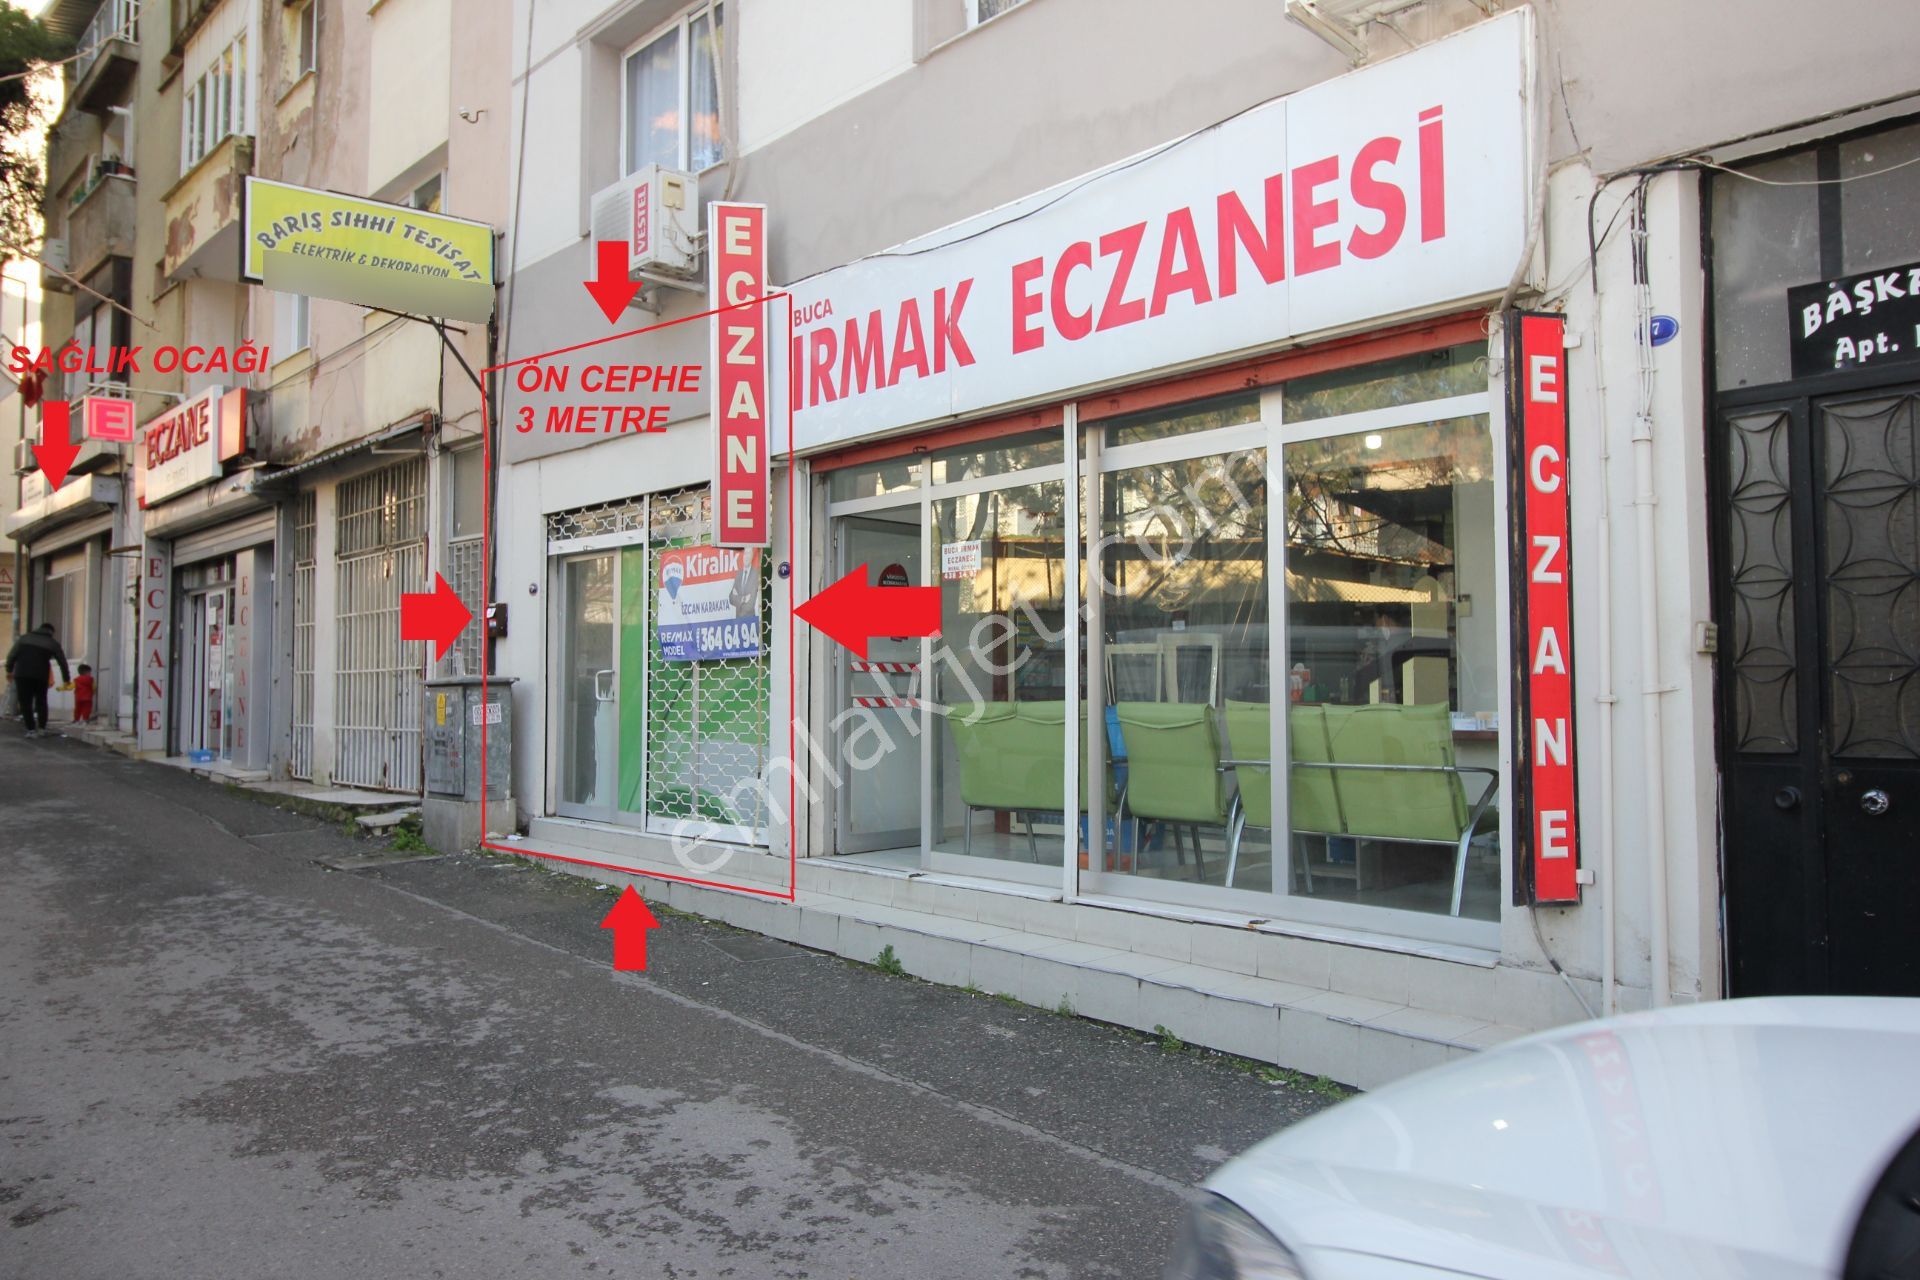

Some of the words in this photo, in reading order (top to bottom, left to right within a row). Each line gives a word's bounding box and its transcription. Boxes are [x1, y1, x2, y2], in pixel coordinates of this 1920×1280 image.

[637, 186, 647, 255] VESTEL
[257, 212, 322, 249] BARIŞ
[330, 211, 396, 234] SIHHİ
[404, 224, 481, 281] TESİSAT
[292, 242, 356, 263] ELEKTRİK
[358, 254, 367, 265] &
[793, 277, 976, 412] IRMAK
[1011, 104, 1446, 355] ECZANESİ
[794, 299, 833, 327] BUCA
[1836, 332, 1899, 362] Apt.
[725, 216, 760, 528] ECZANE
[95, 406, 126, 437] E
[146, 398, 209, 470] ECZANE
[686, 549, 739, 578] Kiralık
[1529, 355, 1567, 859] ECZANE
[147, 558, 164, 731] ECZANE
[661, 630, 693, 643] RE/MAX
[663, 645, 685, 656] MODEL
[701, 626, 723, 652] 364
[724, 624, 740, 650] 64
[741, 622, 759, 648] 94
